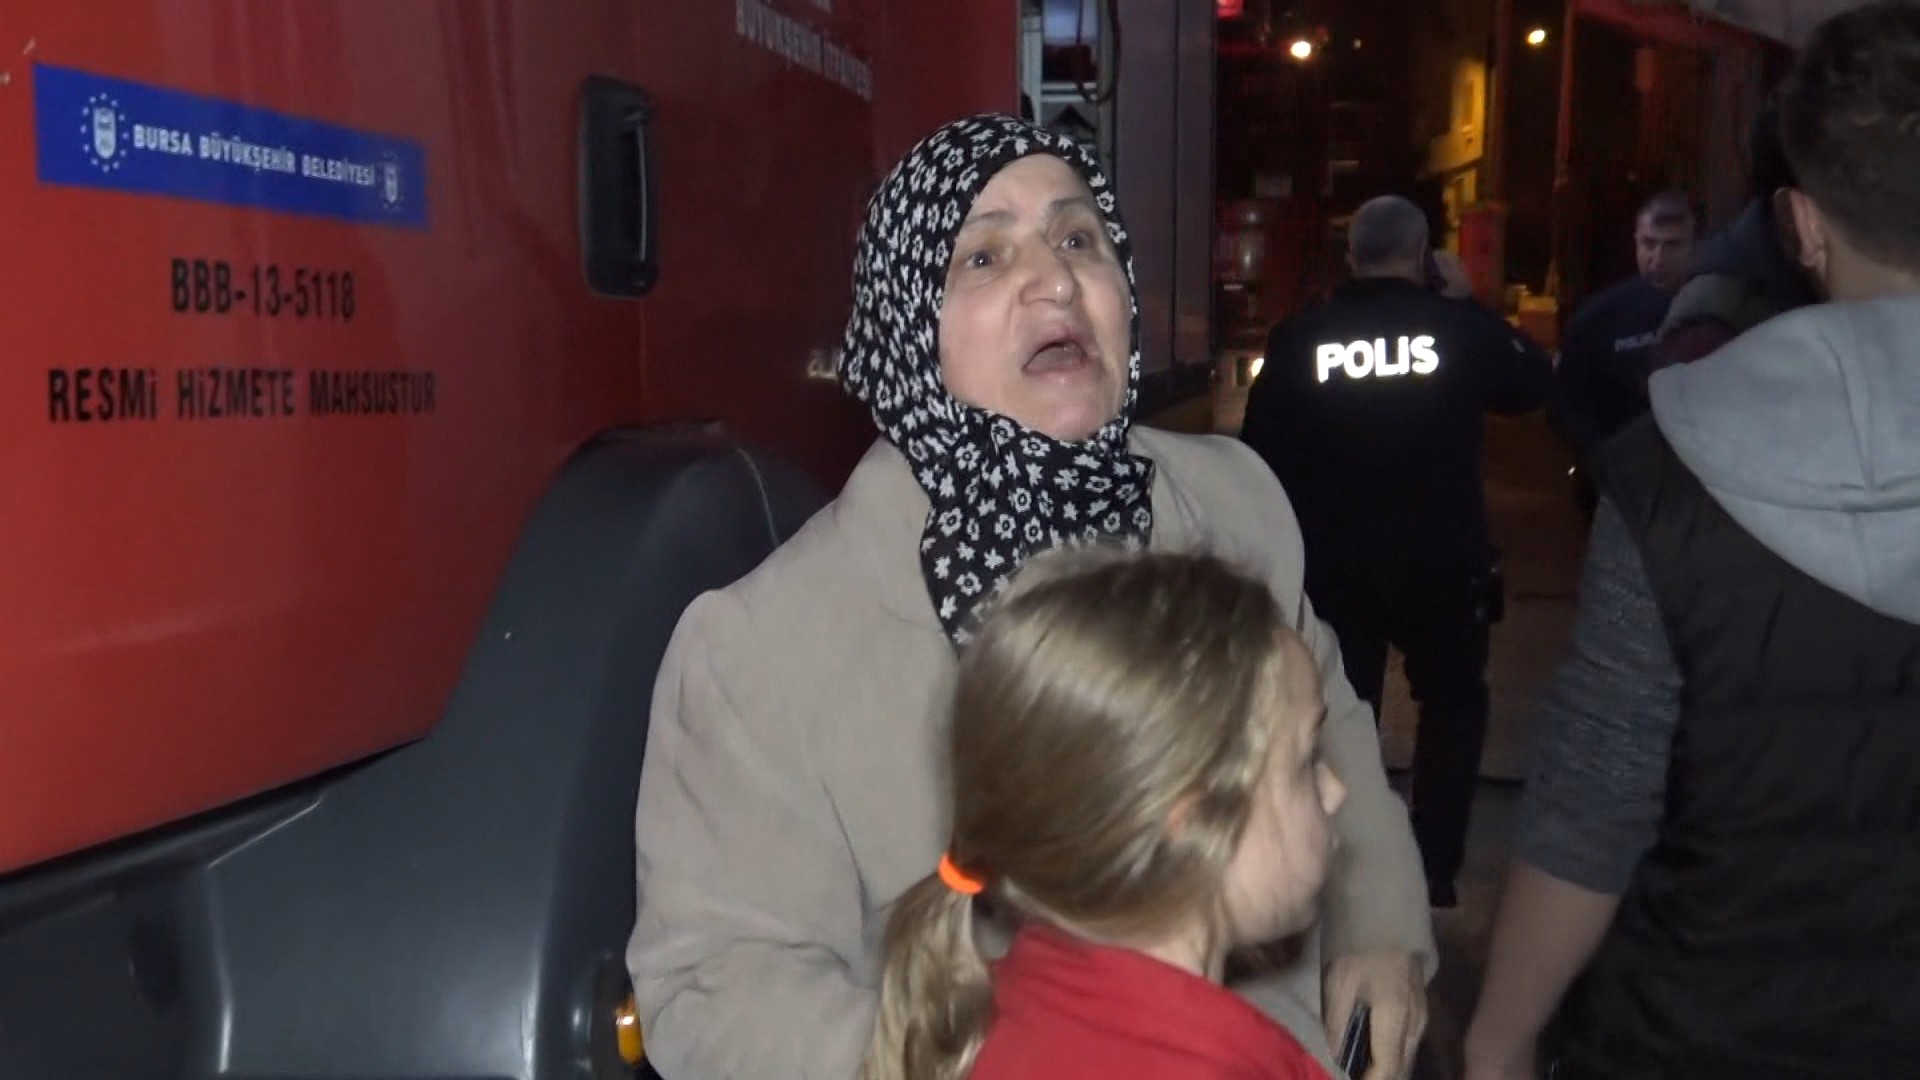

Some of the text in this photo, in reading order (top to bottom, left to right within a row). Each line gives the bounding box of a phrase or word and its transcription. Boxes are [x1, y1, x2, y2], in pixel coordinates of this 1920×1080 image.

[133, 123, 376, 186] BURSA BÜYÜKŞEHİR BELEDİYESİ
[171, 257, 355, 321] BBB-13-5118
[1316, 335, 1440, 383] POLIS
[308, 368, 435, 418] MAHSUSTUR
